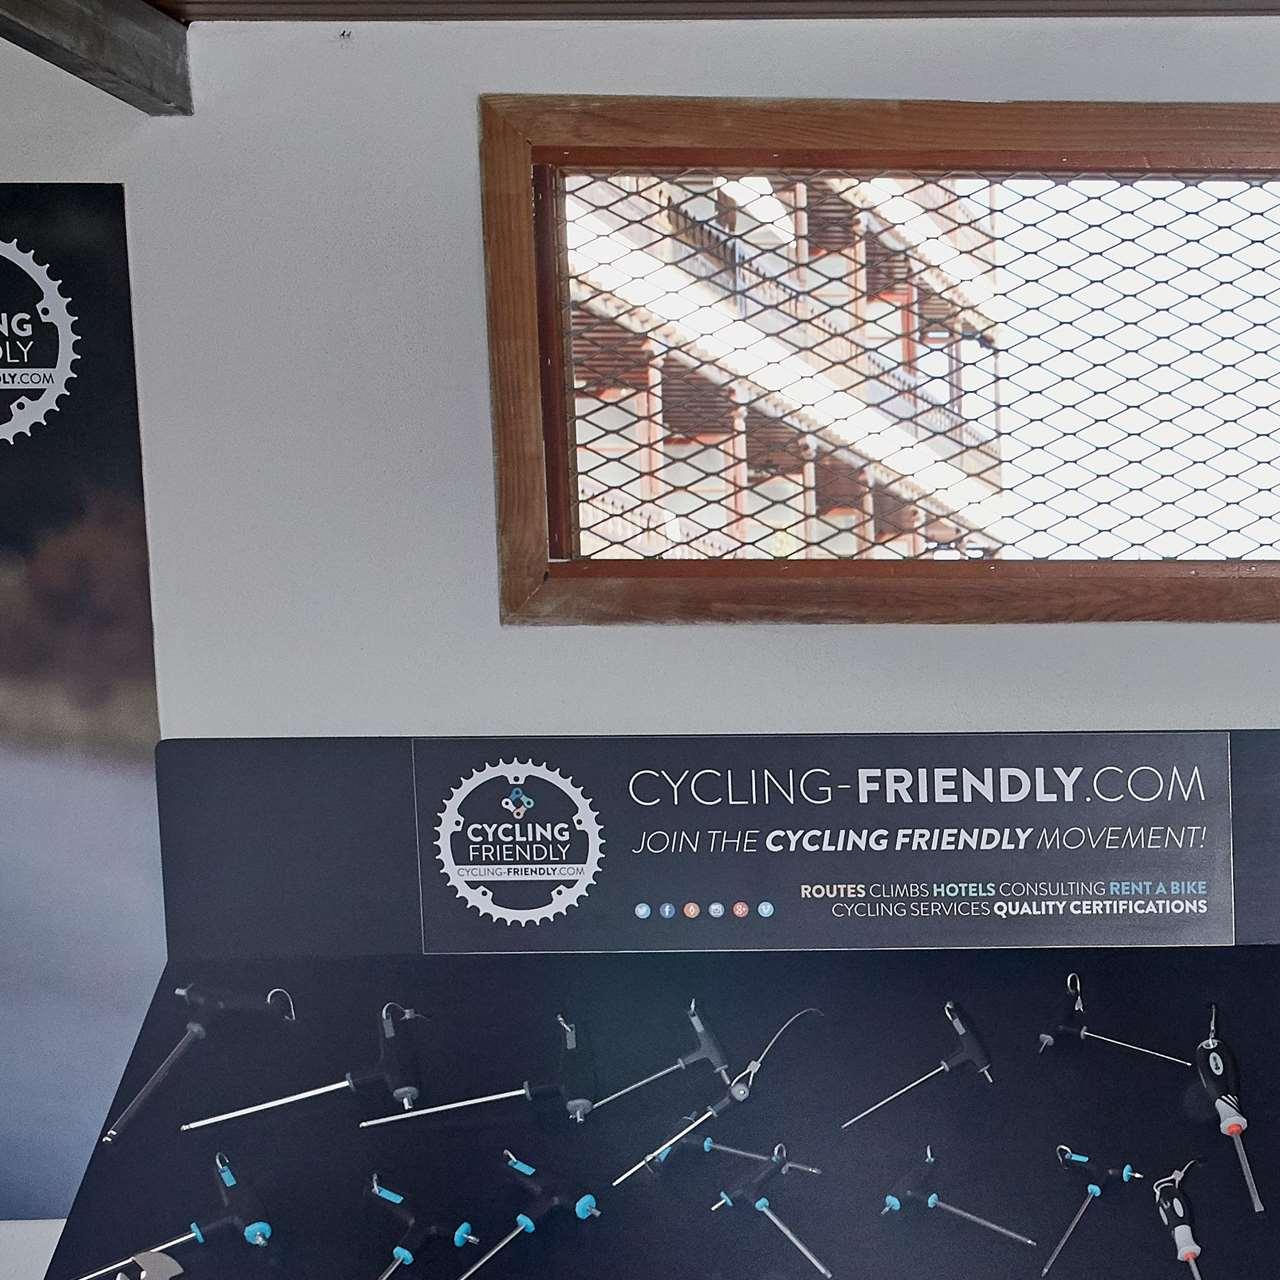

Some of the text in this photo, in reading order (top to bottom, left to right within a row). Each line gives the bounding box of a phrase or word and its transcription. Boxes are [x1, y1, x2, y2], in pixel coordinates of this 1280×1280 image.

[628, 766, 1206, 806] CYCLING-FRIENDLY.COM
[467, 822, 570, 842] CYCLING
[632, 826, 1207, 853] JOIN THE CYCLING FRIENDLY MOVEMENT!
[469, 844, 570, 861] FRIENDLY
[457, 866, 585, 877] CYCLING-FRIENDLY.COM
[800, 881, 1207, 898] ROUTES CLIMBS HOTELS CONSULTING RENT A BIKE
[831, 900, 1208, 918] CYCLING SERVICES QUALITY CERTIFICATIONS
